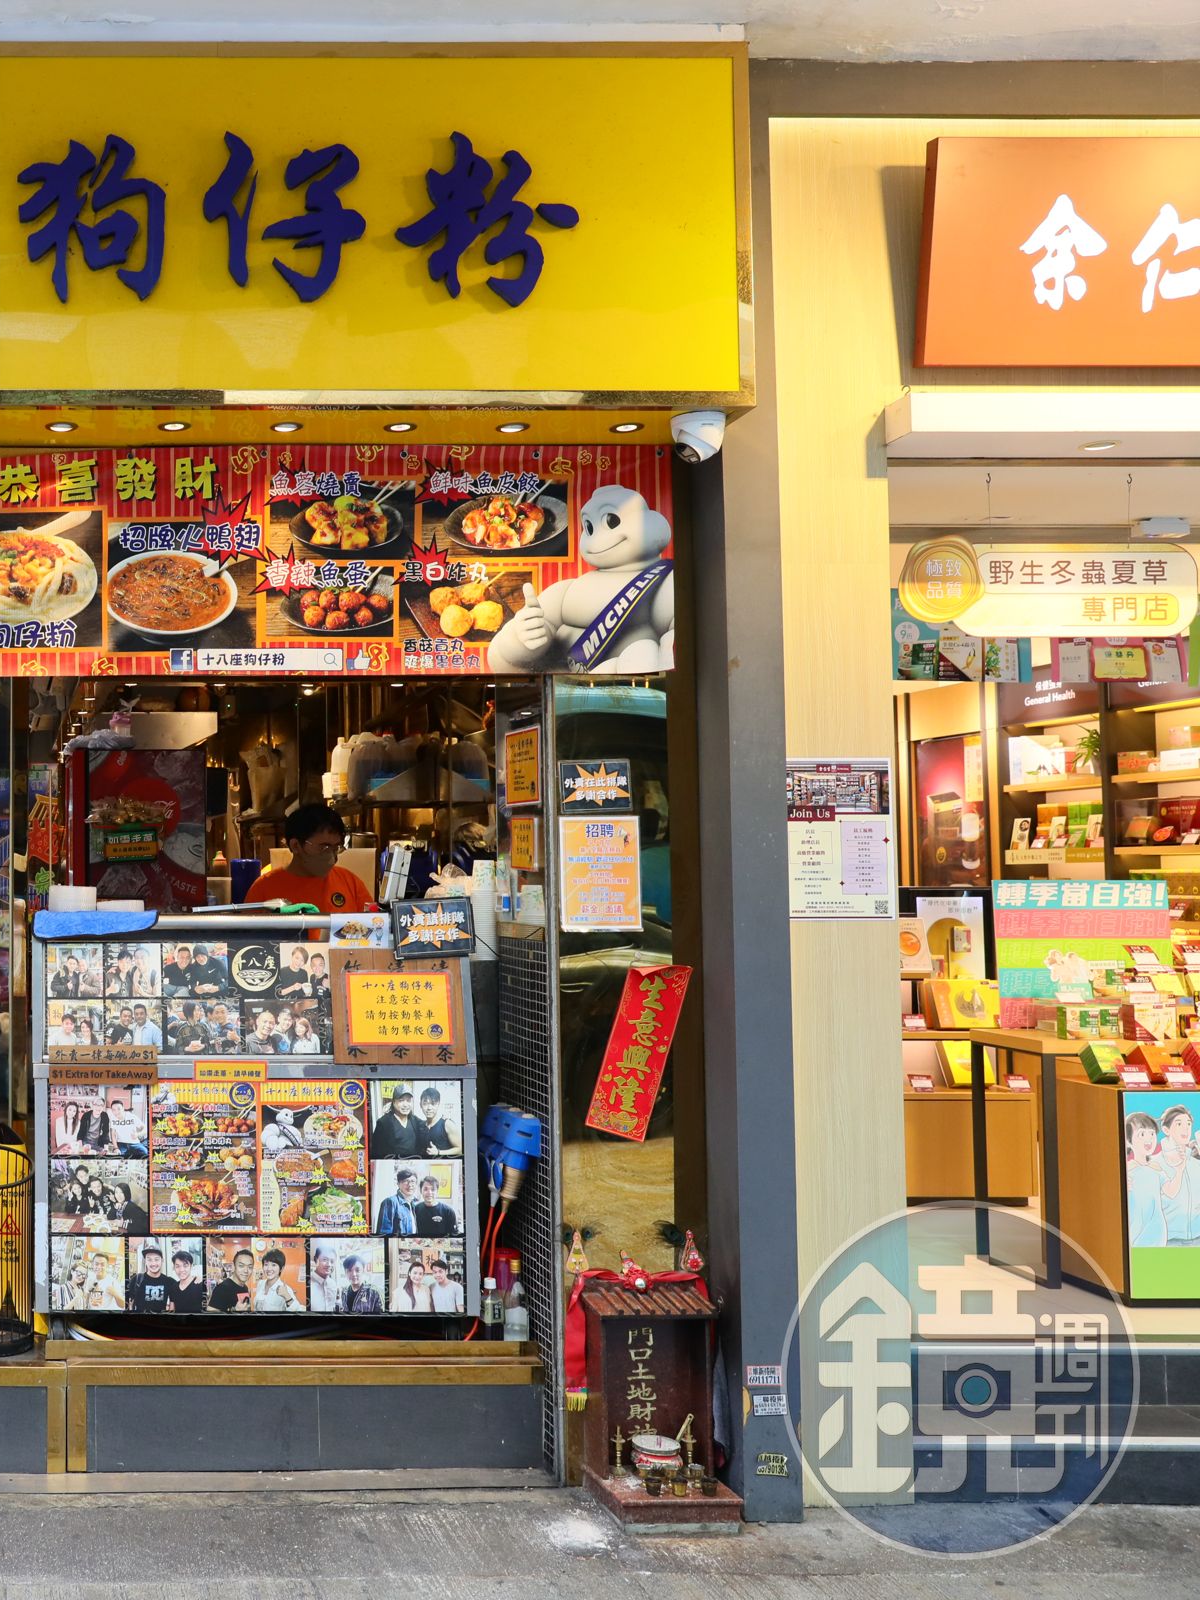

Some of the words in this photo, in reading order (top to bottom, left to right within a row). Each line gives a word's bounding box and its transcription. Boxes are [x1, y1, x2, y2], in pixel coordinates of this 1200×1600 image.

[270, 471, 361, 497] 魚蓉燒賣
[430, 472, 540, 495] 鮮味魚皮餃
[120, 523, 261, 552] 招牌火鴨翅
[266, 559, 371, 588] 香辣魚蛋
[404, 561, 489, 582] 黑白炸丸
[926, 559, 962, 577] 極致
[988, 559, 1169, 586] 野生冬蟲夏草
[926, 581, 963, 598] 品質
[581, 562, 667, 661] MICHELIN
[1081, 597, 1169, 622] 專門店
[202, 653, 286, 667] 十八座狗仔粉
[1024, 693, 1051, 706] General
[1052, 690, 1076, 702] Health
[564, 775, 628, 788] 外賣在此排隊
[575, 790, 618, 801] 多謝合作
[790, 809, 813, 818] Join
[816, 809, 831, 818] Us
[586, 824, 615, 838] 招聘
[995, 882, 1165, 908] 轉季當自強!
[400, 911, 466, 928] 外賣請排隊
[408, 928, 460, 943] 多謝合作
[236, 953, 276, 970] 十八座
[362, 980, 434, 992] 十八座狗仔粉
[376, 994, 423, 1005] 注意安全
[365, 1010, 435, 1021] 請勿按動餐車
[378, 1025, 425, 1036] 請勿攀爬
[608, 975, 668, 1114] 生意興隆
[52, 1071, 63, 1079] $1
[65, 1070, 89, 1079] Extra
[90, 1070, 104, 1079] for
[106, 1070, 154, 1081] TakeAway
[627, 1327, 657, 1441] 門口土地財神
